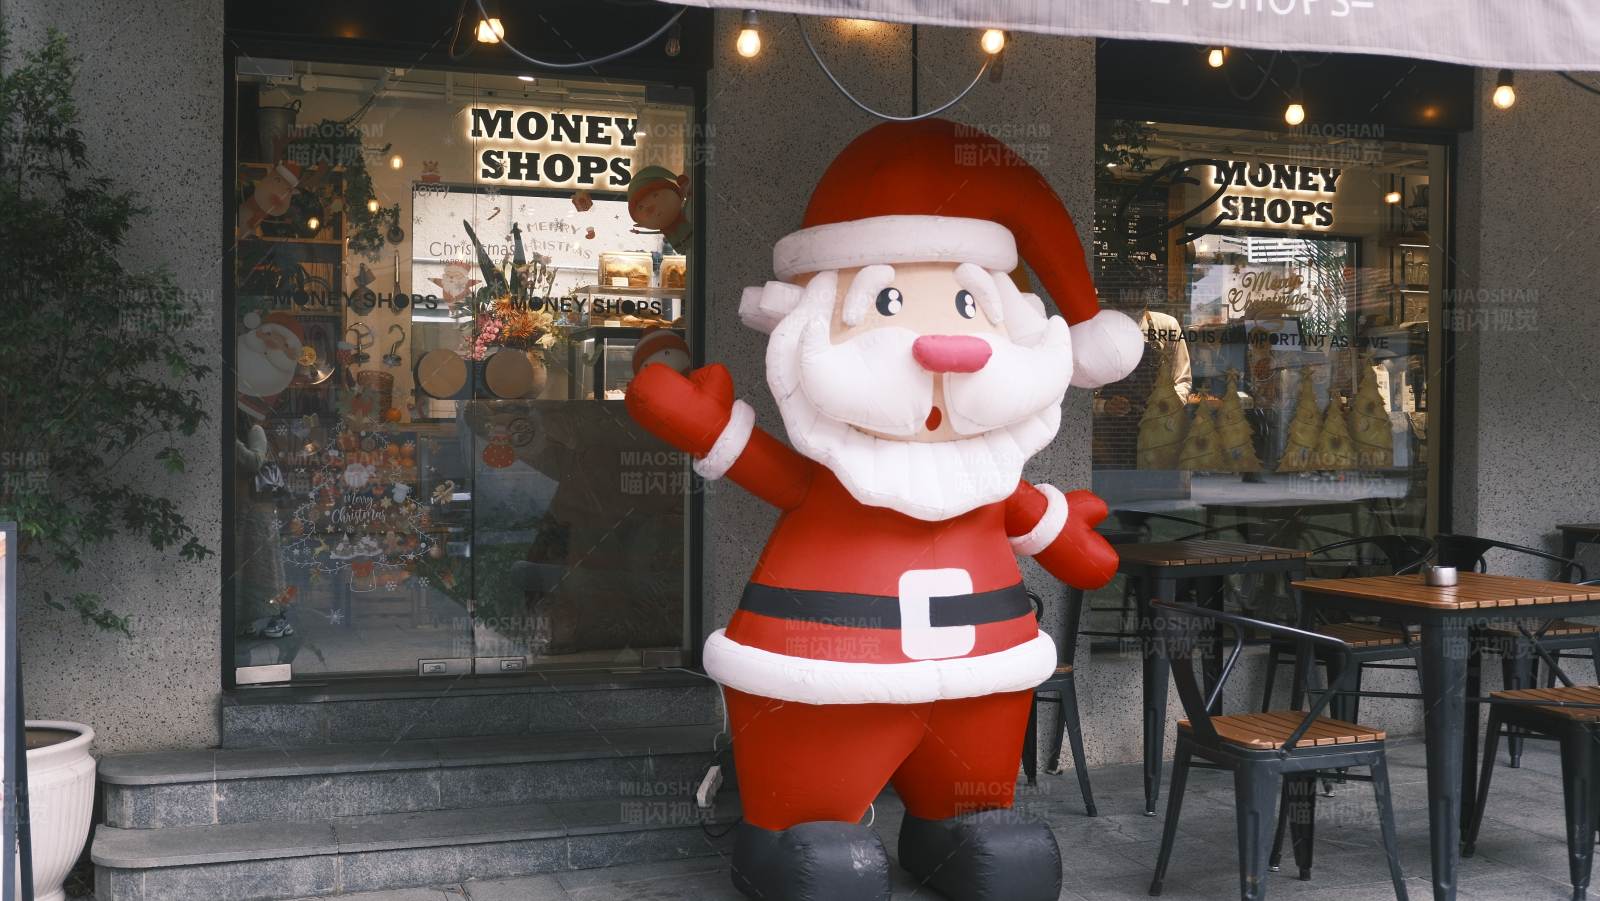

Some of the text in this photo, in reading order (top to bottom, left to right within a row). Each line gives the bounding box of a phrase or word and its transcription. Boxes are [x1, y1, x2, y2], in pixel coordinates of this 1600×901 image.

[471, 108, 638, 147] MONEY
[481, 149, 632, 187] SHOPS
[1213, 160, 1342, 193] MONEY
[1221, 195, 1334, 227] SHOPS
[273, 291, 356, 309] MONEY
[364, 292, 437, 311] SHOPS
[511, 296, 663, 316] MONEY SHOPS
[1227, 287, 1314, 314] Christmas
[1147, 328, 1198, 343] BREAD
[1203, 330, 1217, 343] IS
[1331, 334, 1349, 347] AS
[343, 494, 375, 512] Merry
[331, 506, 387, 525] Christmas
